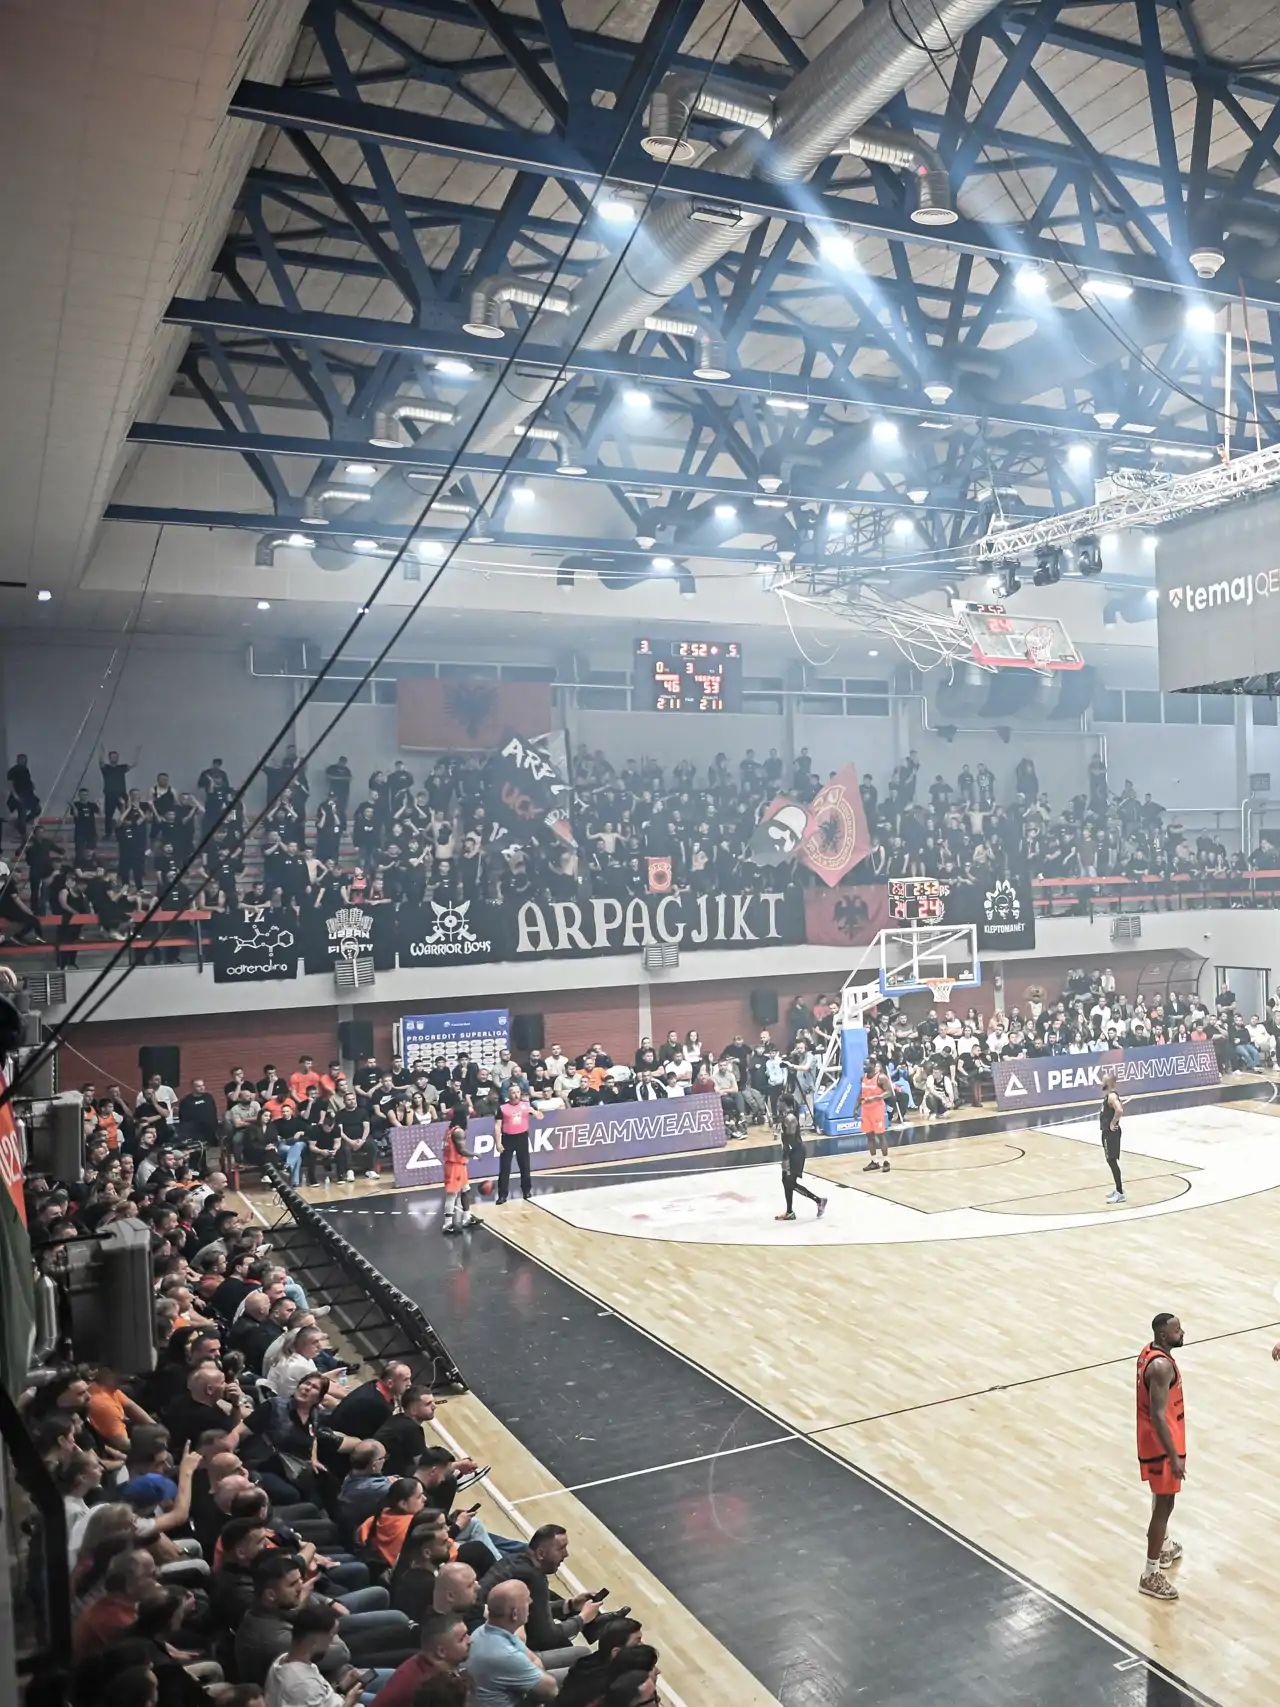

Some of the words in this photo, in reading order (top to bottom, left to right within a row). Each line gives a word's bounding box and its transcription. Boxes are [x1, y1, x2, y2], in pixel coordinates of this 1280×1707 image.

[1186, 575, 1255, 612] temaj
[679, 643, 708, 656] 2:52
[686, 662, 694, 674] 3
[703, 681, 720, 694] 53
[516, 893, 785, 953] ARPAGJIKT
[983, 922, 1026, 934] KLEPTOMANËT
[410, 943, 462, 956] WARRIOR
[406, 1033, 457, 1042] PROCREDIT
[460, 1029, 508, 1039] SUPERLIGA
[1047, 1064, 1102, 1091] PEAK
[1101, 1052, 1211, 1083] TEAMWEAR
[473, 1127, 555, 1160] PK
[555, 1110, 714, 1150] TEAMWEAR
